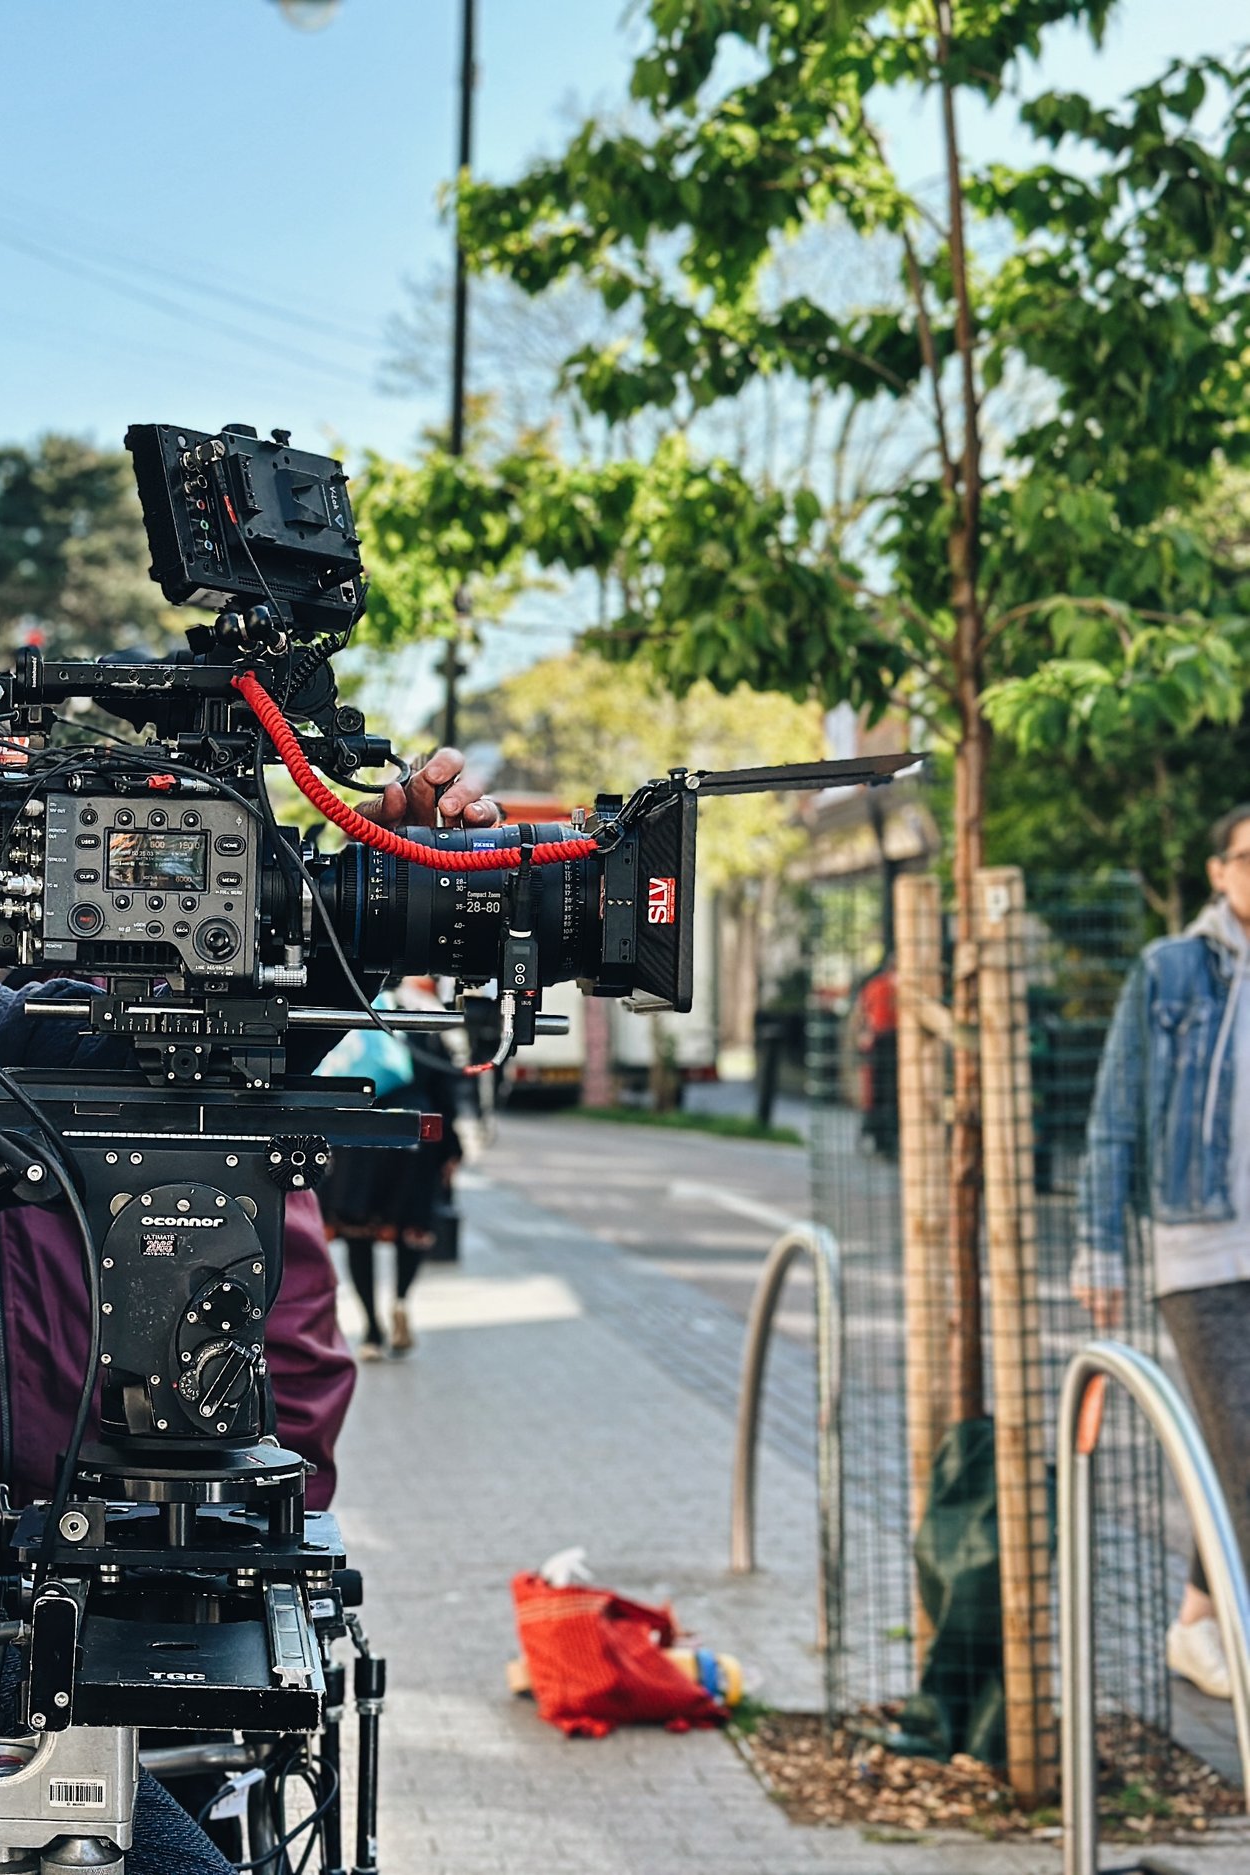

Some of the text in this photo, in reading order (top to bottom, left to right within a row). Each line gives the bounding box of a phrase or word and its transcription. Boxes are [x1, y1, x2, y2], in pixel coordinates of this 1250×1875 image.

[466, 890, 487, 899] Compact
[648, 877, 668, 924] SLV
[466, 901, 501, 913] 28-80
[141, 1216, 224, 1228] oconnor
[149, 1671, 206, 1680] TGC
